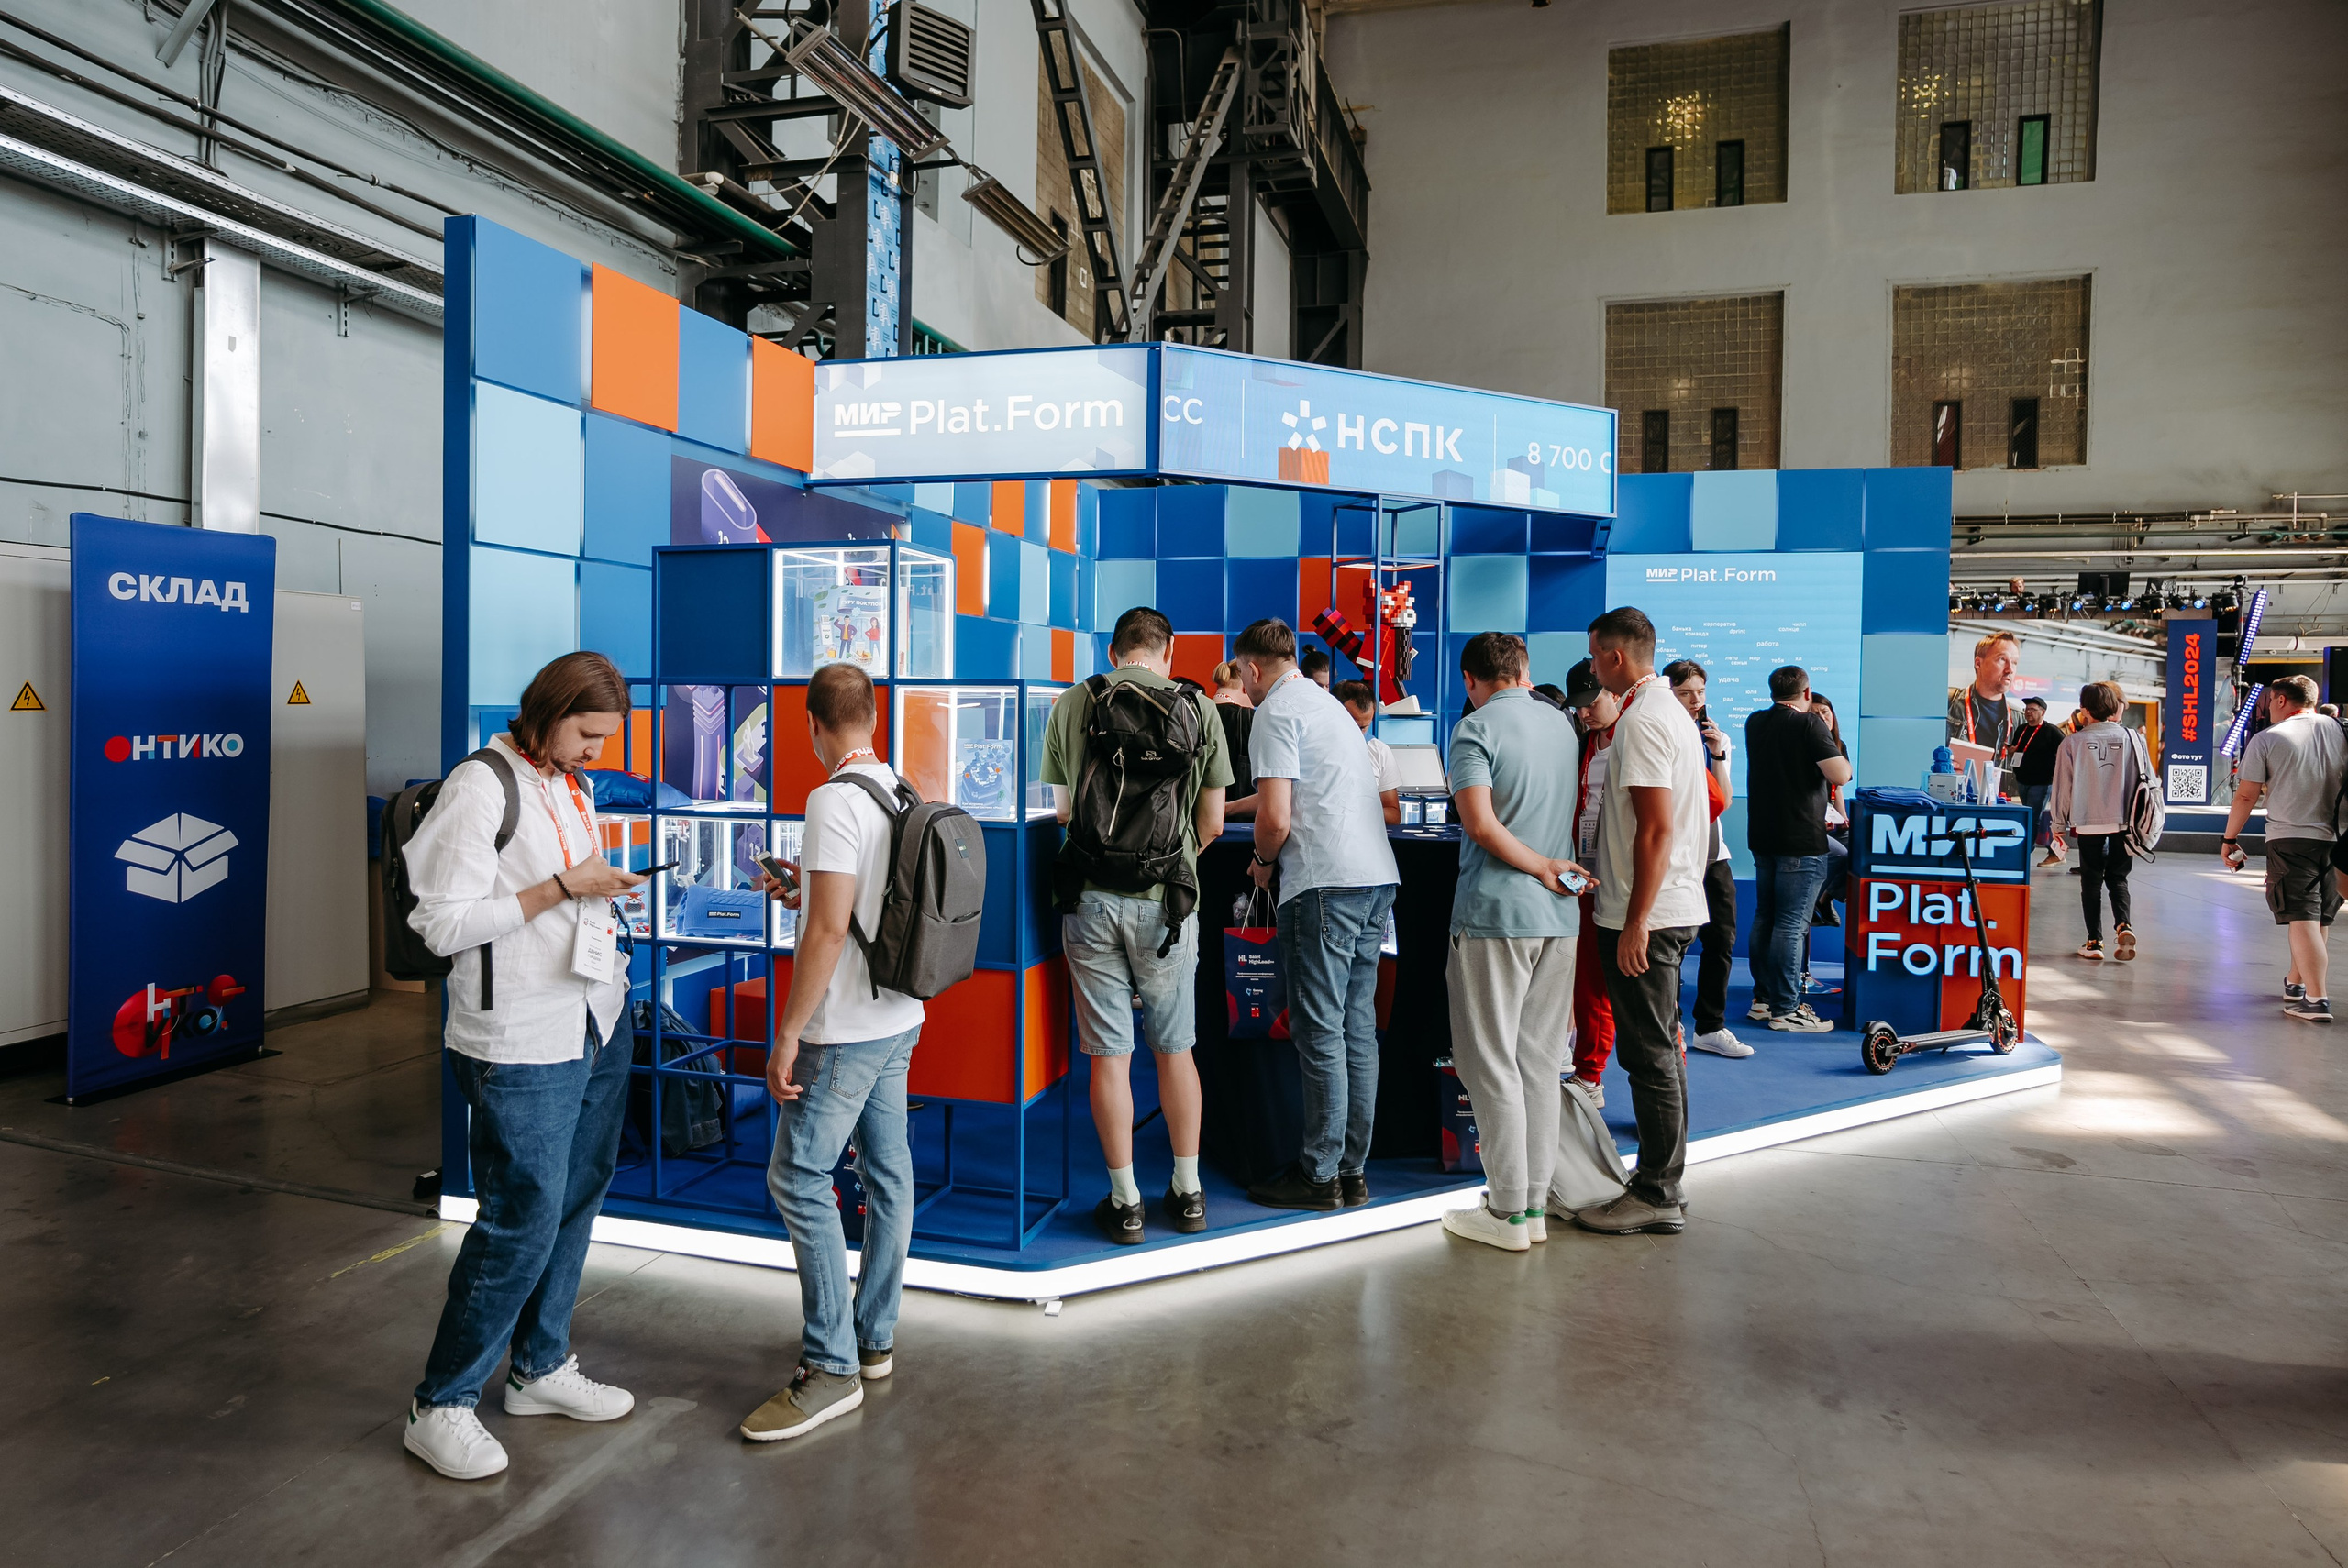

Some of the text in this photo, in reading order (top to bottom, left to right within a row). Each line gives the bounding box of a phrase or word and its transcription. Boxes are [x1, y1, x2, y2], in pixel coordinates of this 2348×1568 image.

[835, 395, 1124, 435] МИР Plat.Form
[1337, 413, 1463, 462] НСПК
[1527, 442, 1541, 465] 8
[1549, 444, 1592, 471] 700
[108, 571, 249, 613] СКЛАД
[1646, 568, 1776, 582] МИР Plat.Form
[2182, 633, 2200, 742] #SHL2024
[1872, 814, 2025, 857] МИР
[1869, 882, 1998, 929] Plat.
[1867, 932, 2022, 979] Form
